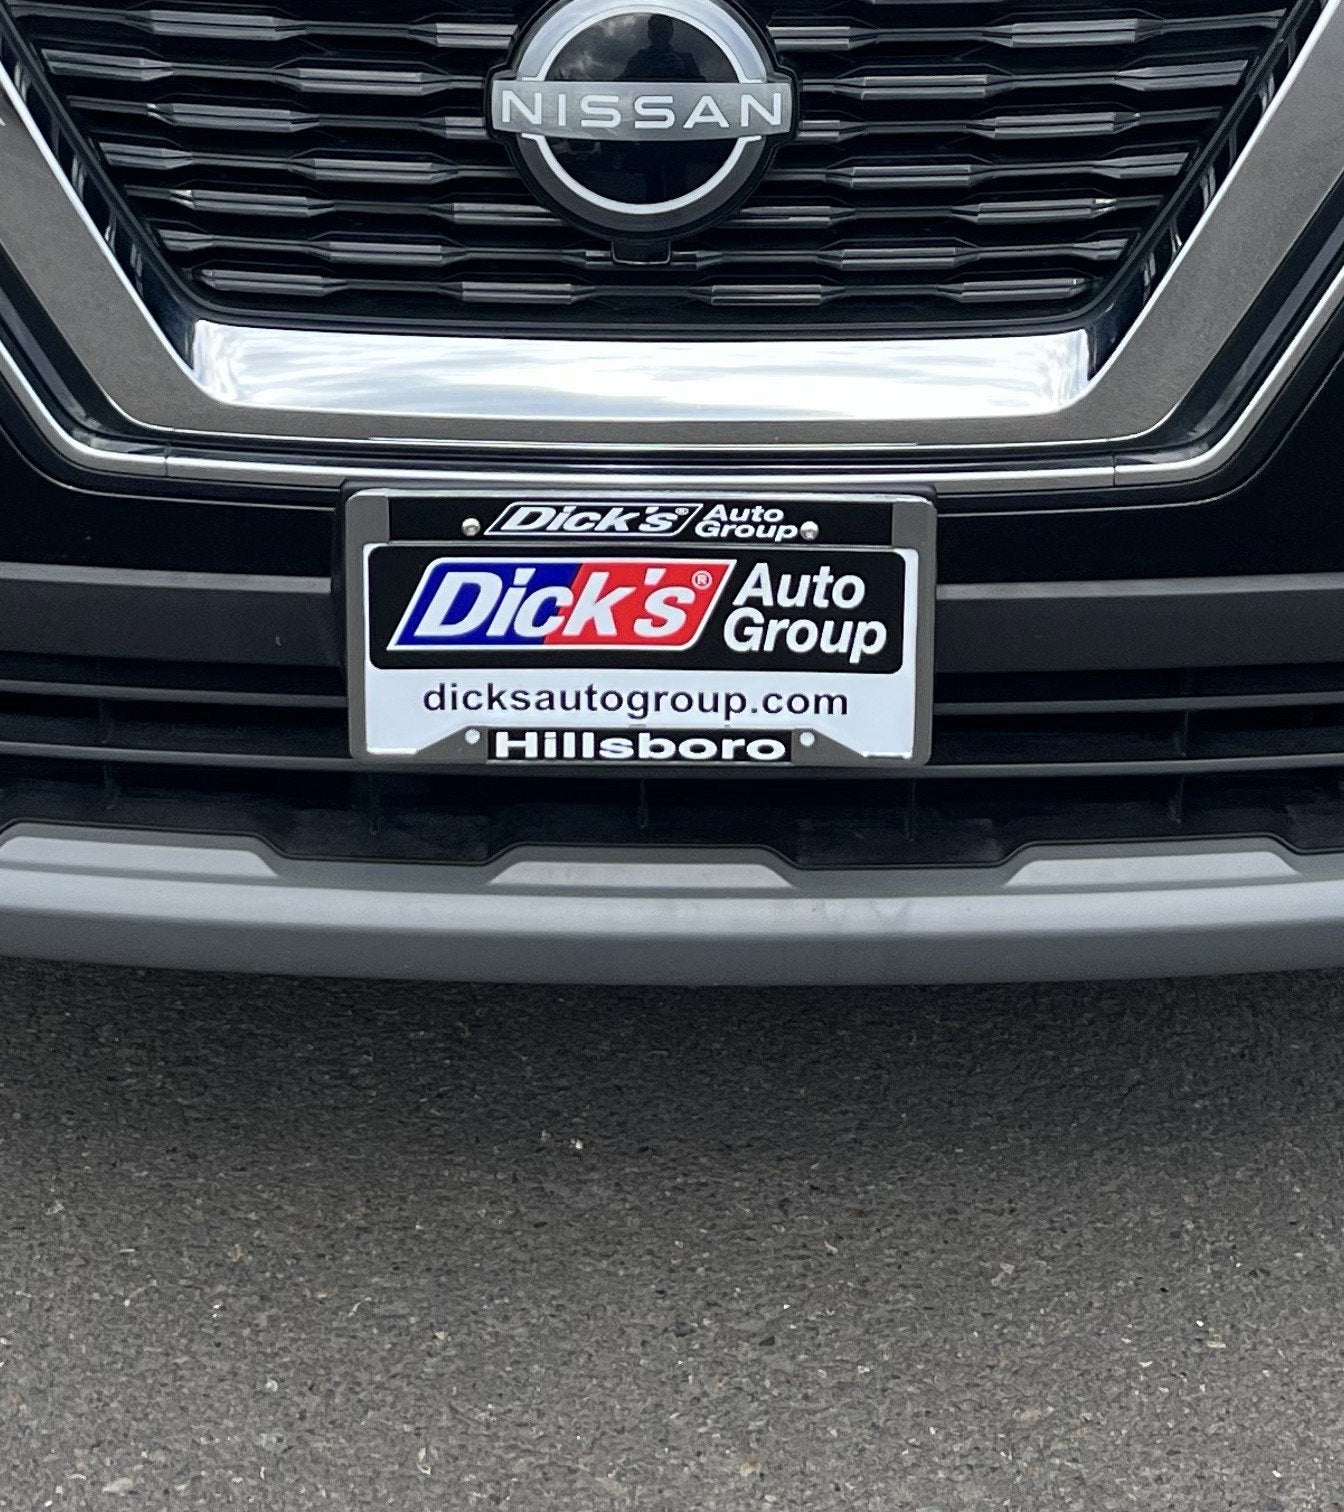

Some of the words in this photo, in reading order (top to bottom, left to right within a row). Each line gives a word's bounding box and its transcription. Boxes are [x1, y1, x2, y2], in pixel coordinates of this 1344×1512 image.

[502, 90, 782, 129] NISSAN
[694, 520, 798, 542] Group
[703, 504, 785, 522] Auto
[413, 566, 695, 639] Dick's
[732, 562, 866, 609] Auto
[724, 609, 887, 663] Group
[423, 681, 849, 719] dicksautogroup.com
[495, 731, 786, 761] Hillsboro
